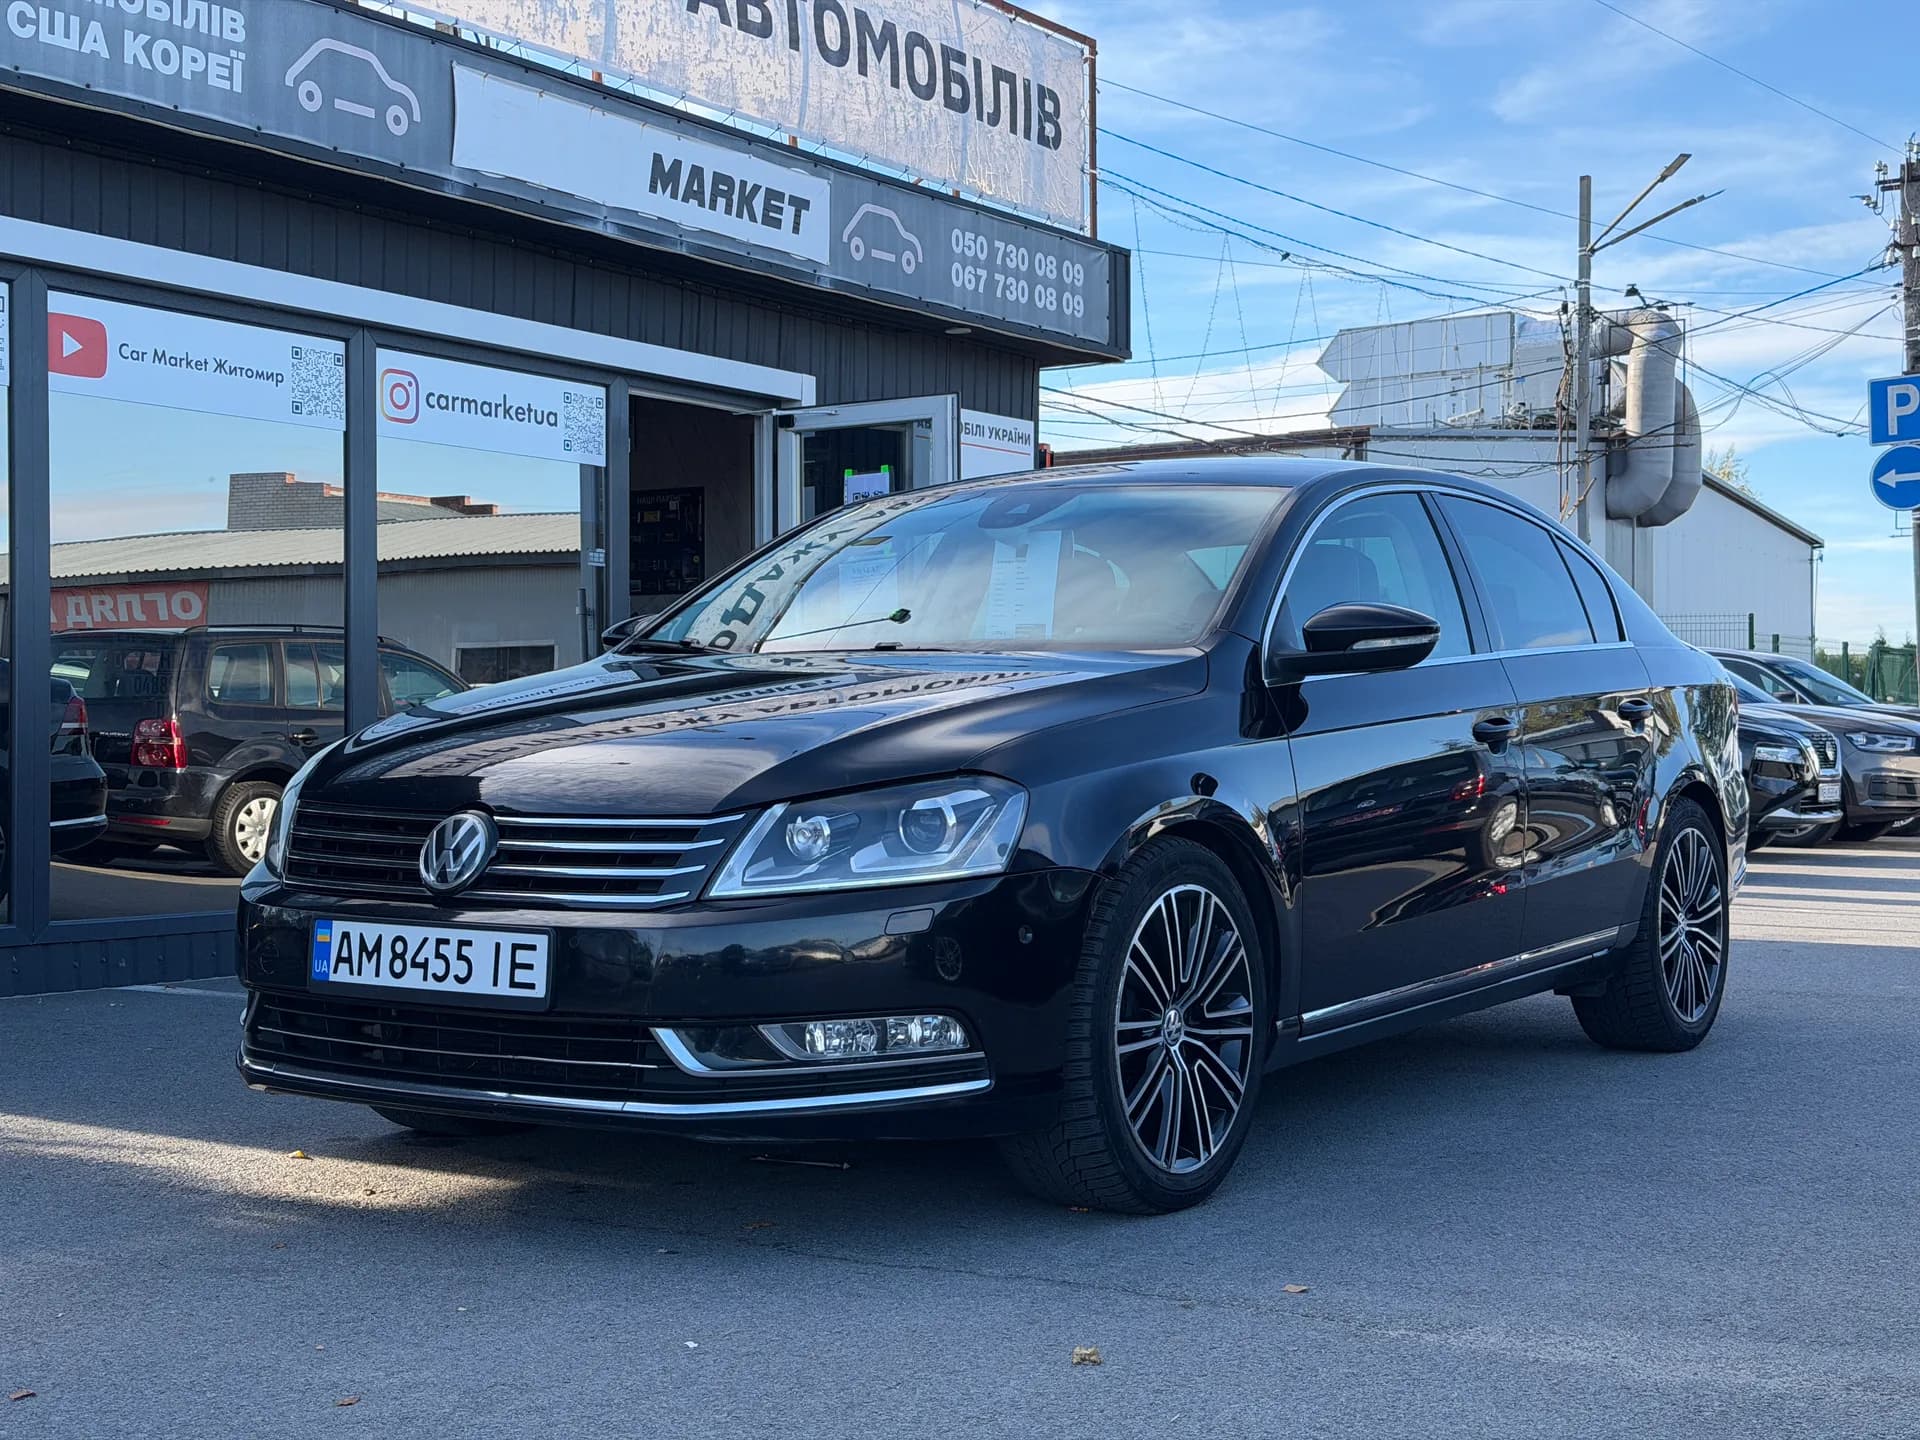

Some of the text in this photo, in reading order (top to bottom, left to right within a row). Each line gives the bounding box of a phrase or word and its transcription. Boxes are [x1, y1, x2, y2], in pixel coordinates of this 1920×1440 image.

[7, 1, 246, 94] США КОРЕЇ
[649, 152, 811, 235] MARKET
[952, 228, 1084, 287] 050 730 08 09
[952, 262, 1084, 318] 067 730 08 09
[118, 343, 285, 387] Car Market Житомир
[425, 391, 559, 428] carmarketua
[1887, 384, 1920, 435] P
[988, 426, 1031, 447] УКРАЇНИ
[314, 959, 329, 973] UA
[492, 941, 538, 990] IE
